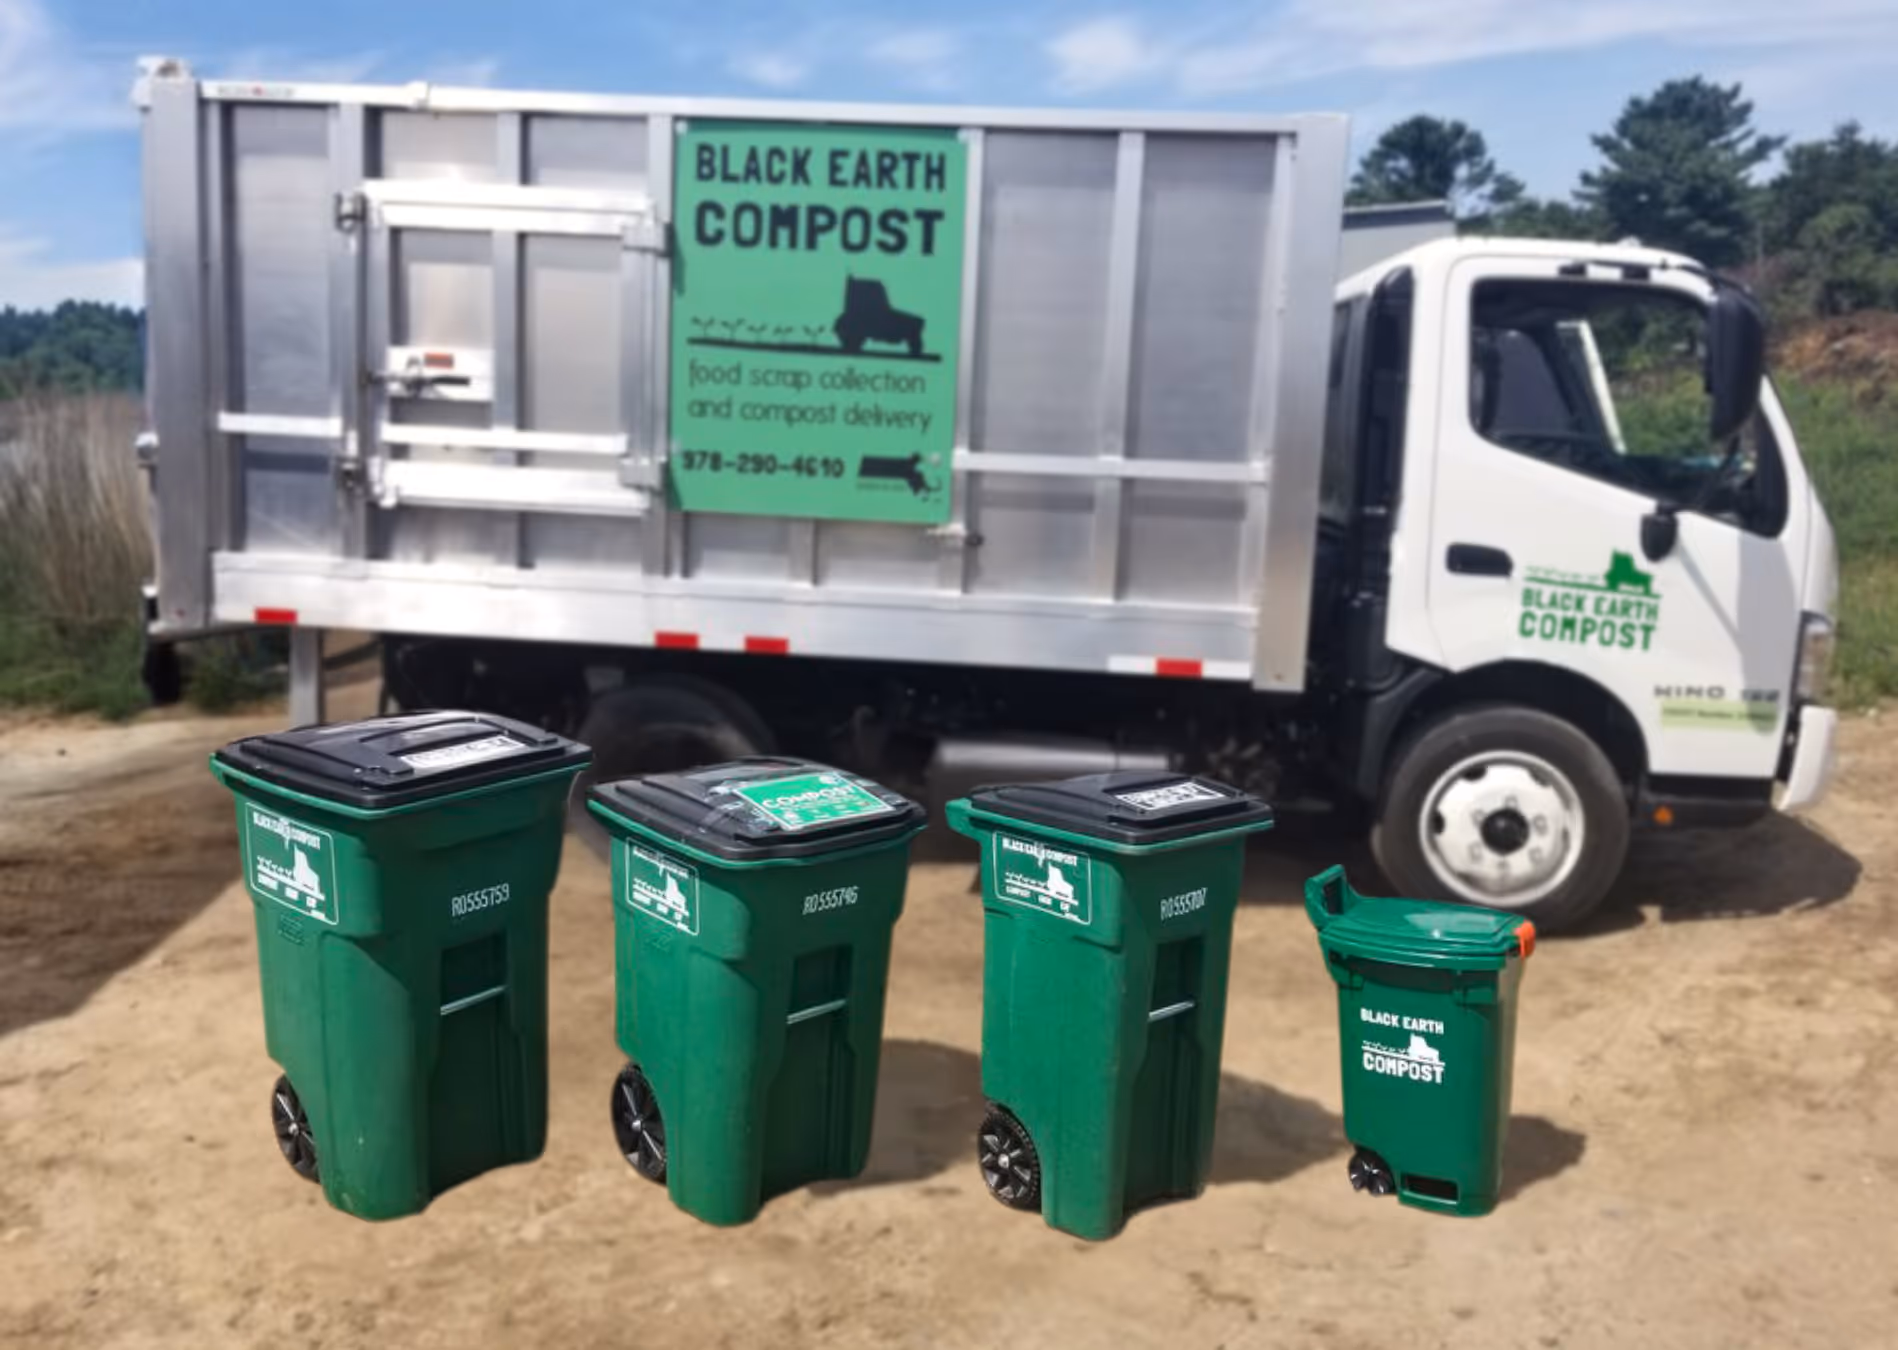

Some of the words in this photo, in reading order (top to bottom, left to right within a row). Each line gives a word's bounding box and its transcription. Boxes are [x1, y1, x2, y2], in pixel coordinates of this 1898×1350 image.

[696, 143, 812, 186] BLACK
[828, 149, 945, 192] EARTH
[695, 200, 945, 257] COMPOST
[689, 358, 741, 389] food
[750, 368, 812, 393] scrap
[819, 366, 926, 394] collection
[688, 396, 732, 420] and
[740, 403, 836, 428] compost
[844, 402, 932, 435] delivery
[1522, 587, 1586, 613] BLACK
[1594, 594, 1659, 621] EARTH
[1519, 610, 1656, 652] COMPOST
[1654, 685, 1725, 699] HINO
[1360, 1007, 1400, 1027] BLACK
[1402, 1016, 1444, 1035] EARTH
[1363, 1052, 1444, 1085] COMPOST
